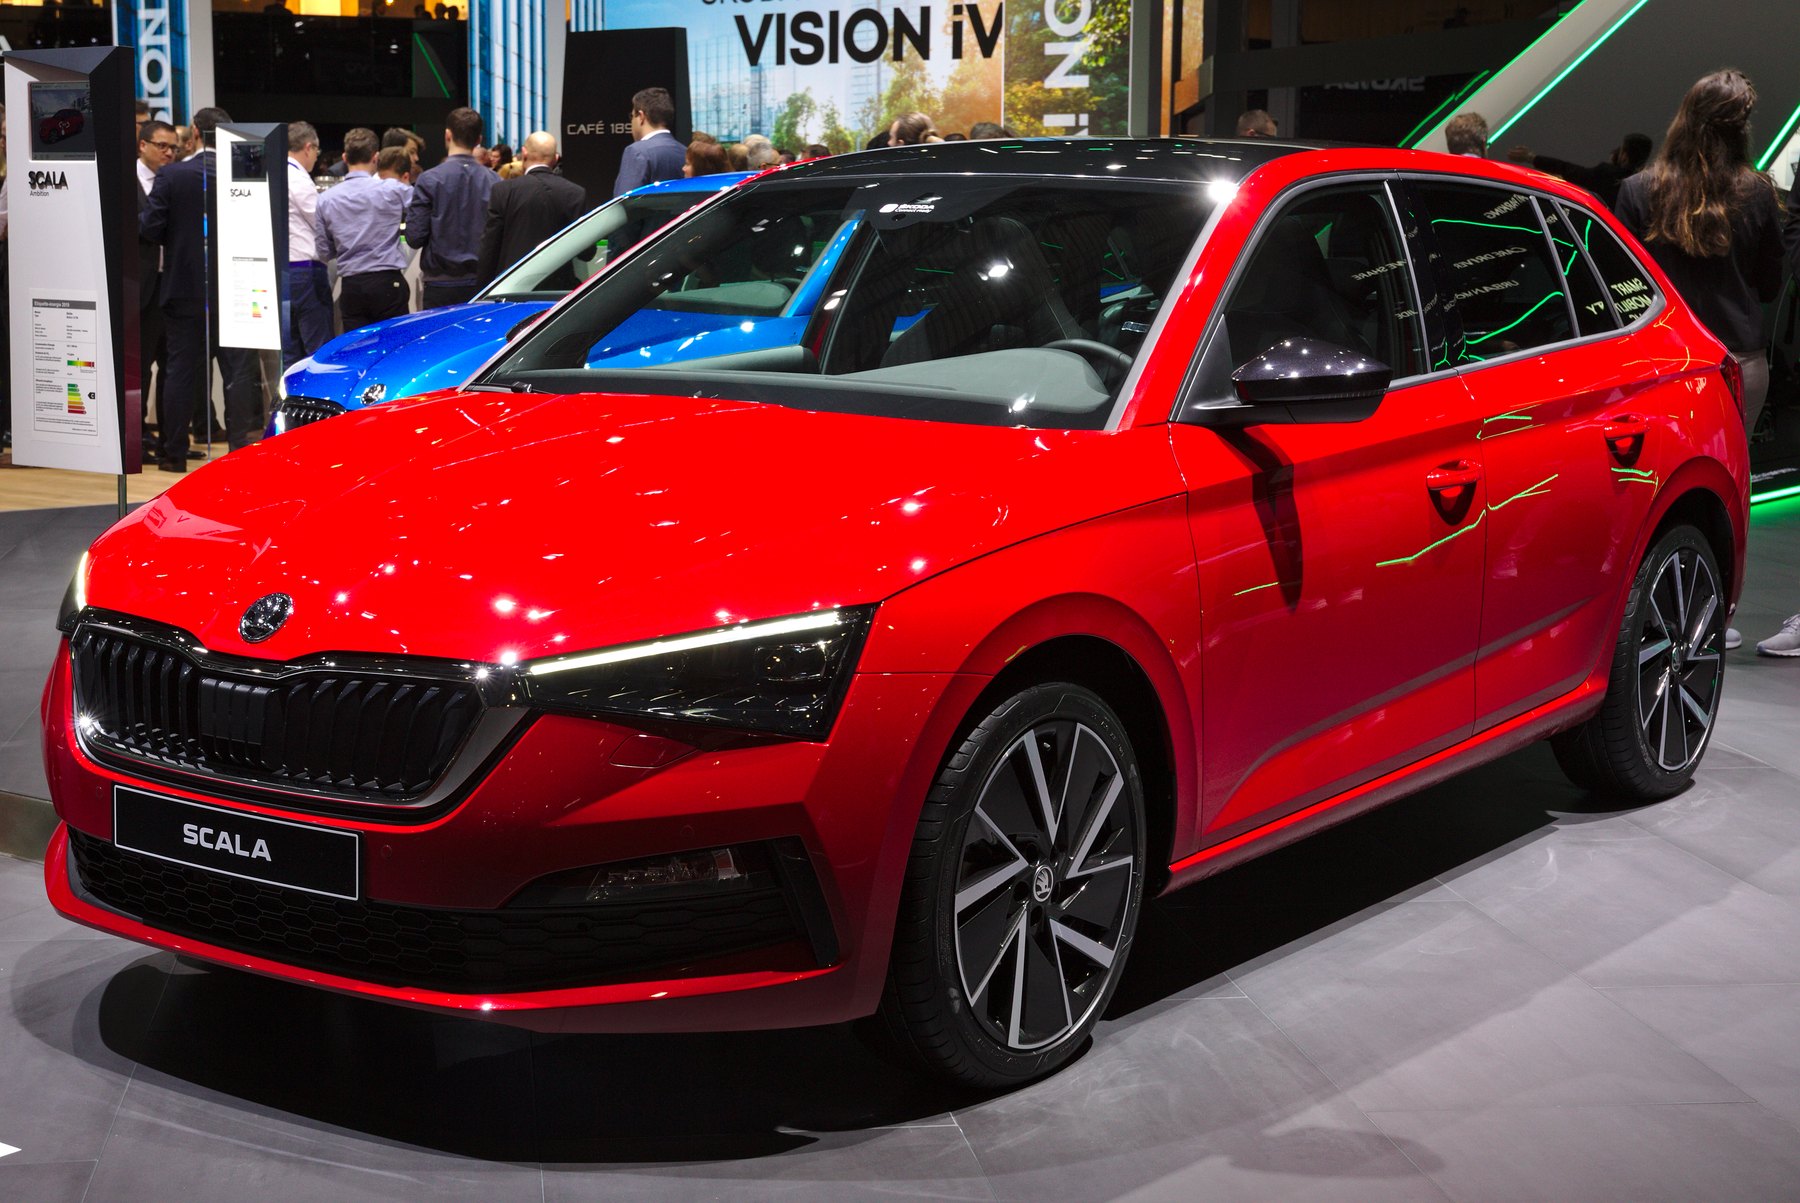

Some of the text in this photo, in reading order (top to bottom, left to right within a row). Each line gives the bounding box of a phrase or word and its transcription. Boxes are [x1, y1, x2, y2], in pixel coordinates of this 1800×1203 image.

[734, 3, 1003, 66] VISION iV
[567, 120, 633, 135] CAFÉ 189
[28, 171, 68, 189] SCALA
[230, 188, 252, 197] SCALA
[183, 823, 272, 862] SCALA
